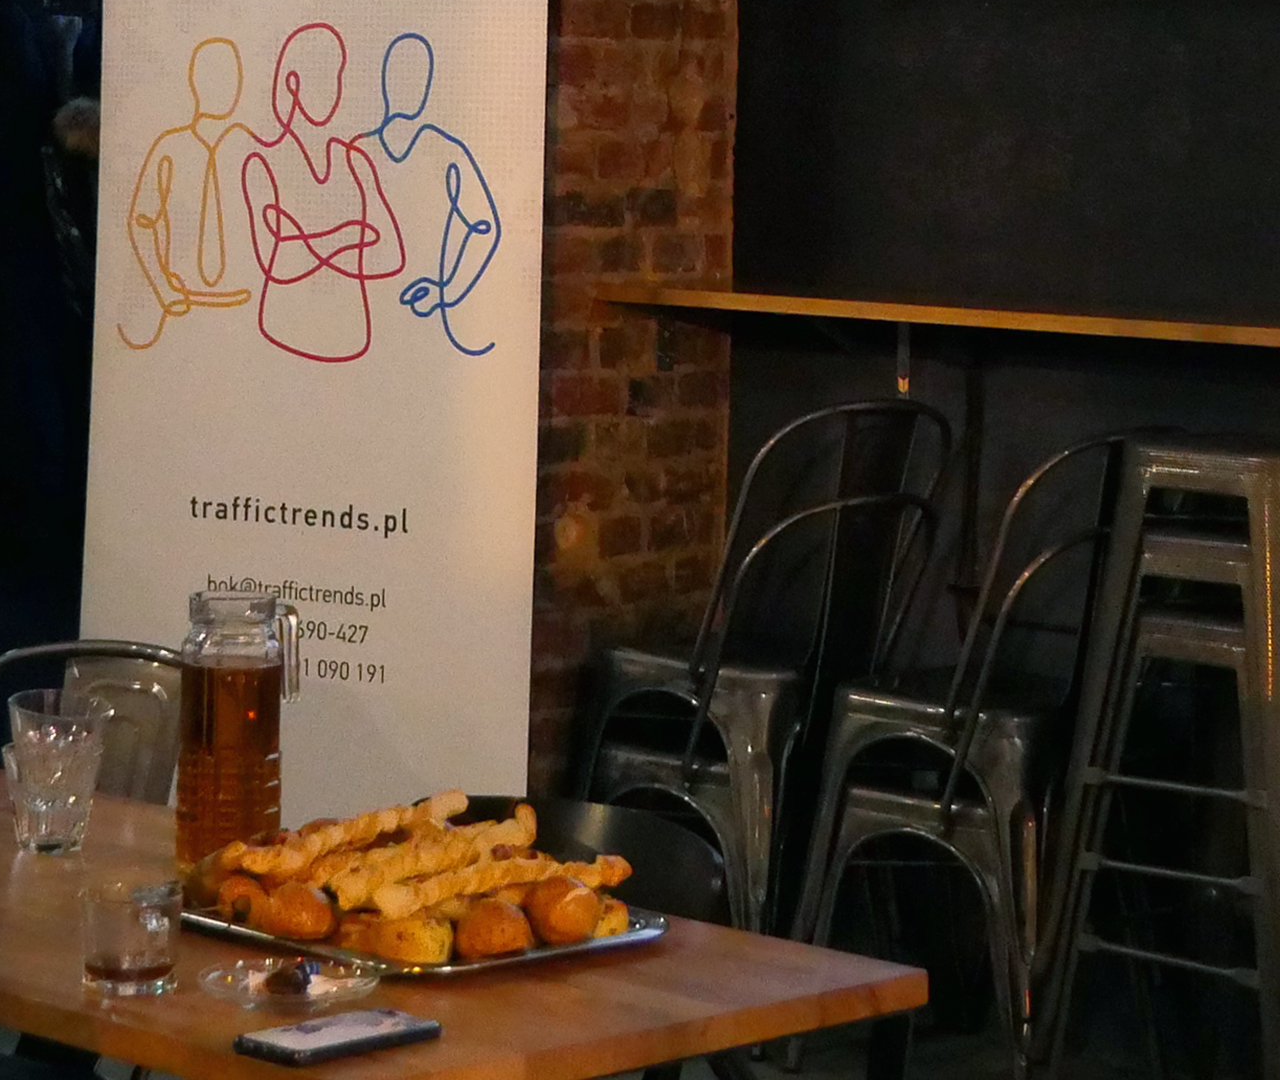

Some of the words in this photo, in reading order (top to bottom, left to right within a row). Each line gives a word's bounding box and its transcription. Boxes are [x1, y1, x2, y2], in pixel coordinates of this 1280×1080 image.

[189, 496, 410, 538] traffictrends.pl
[317, 658, 350, 681] 090
[357, 662, 385, 684] 191
